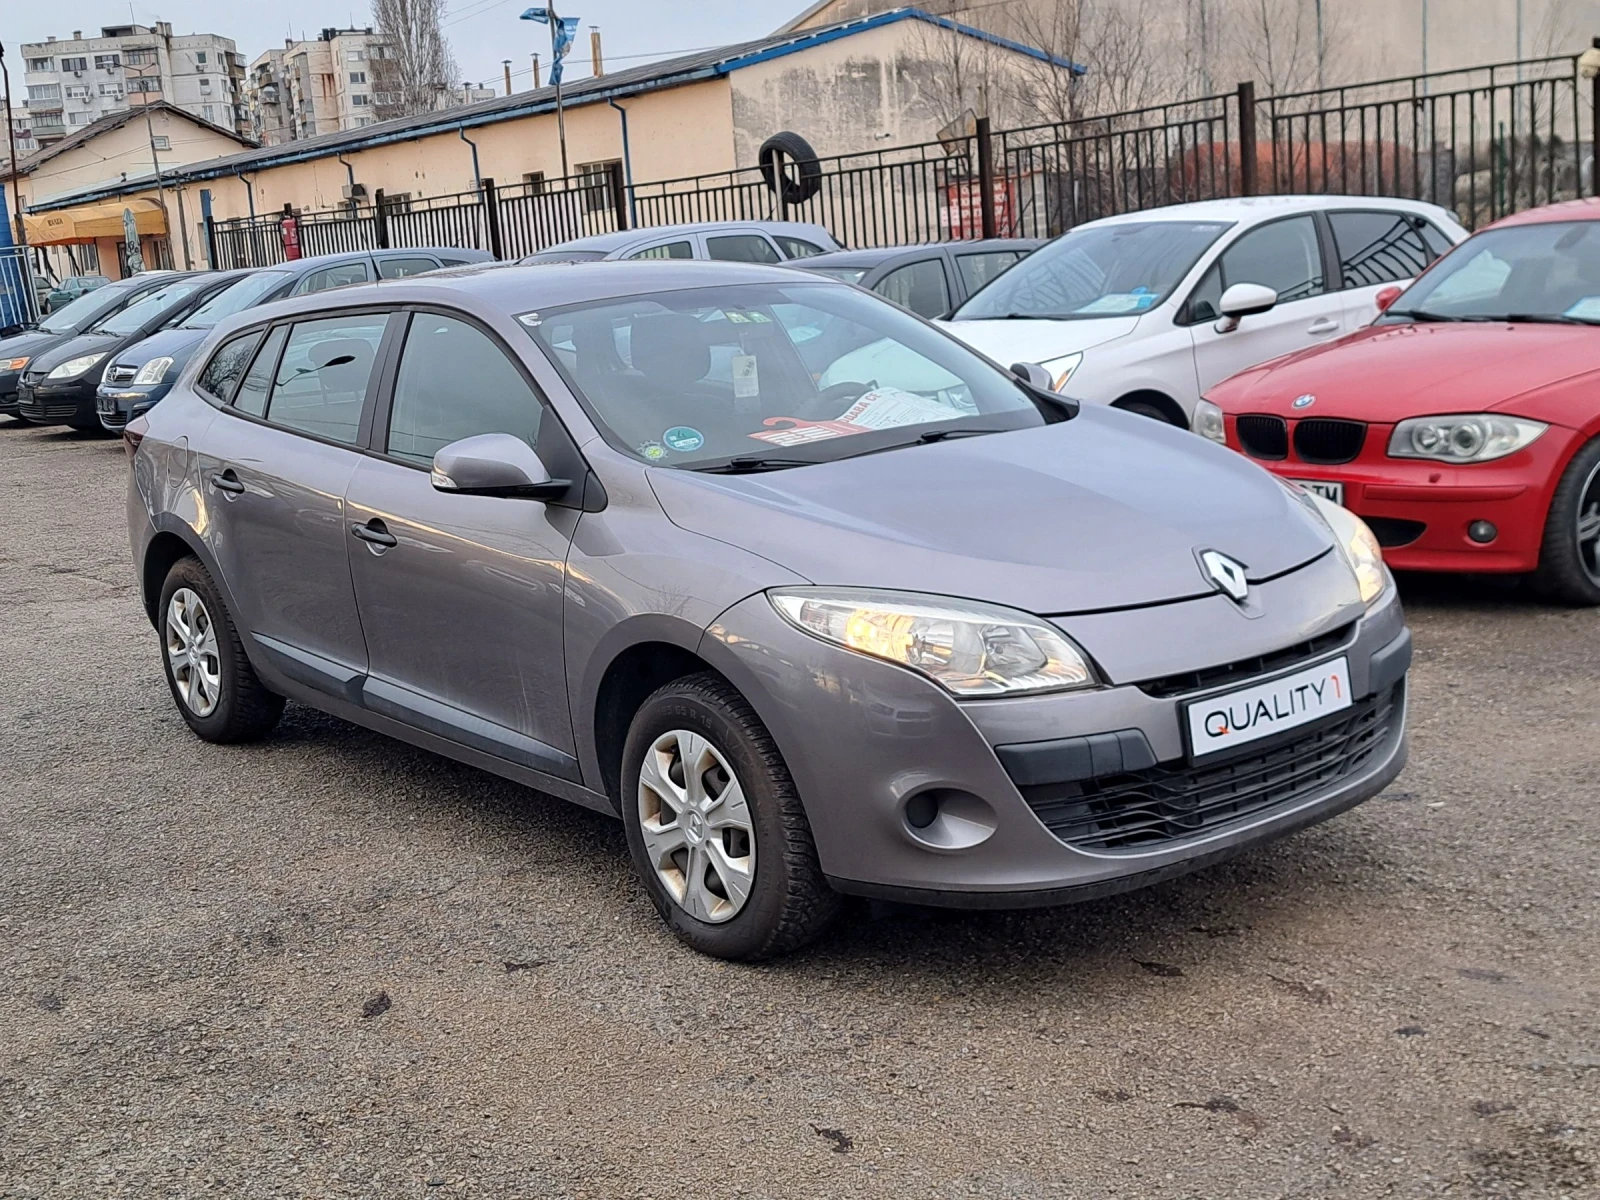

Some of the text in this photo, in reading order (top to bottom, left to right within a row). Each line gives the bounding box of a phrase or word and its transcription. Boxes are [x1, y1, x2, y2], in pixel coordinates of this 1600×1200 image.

[690, 708, 697, 719] R
[700, 714, 713, 729] 15
[1204, 677, 1326, 738] QUALITY
